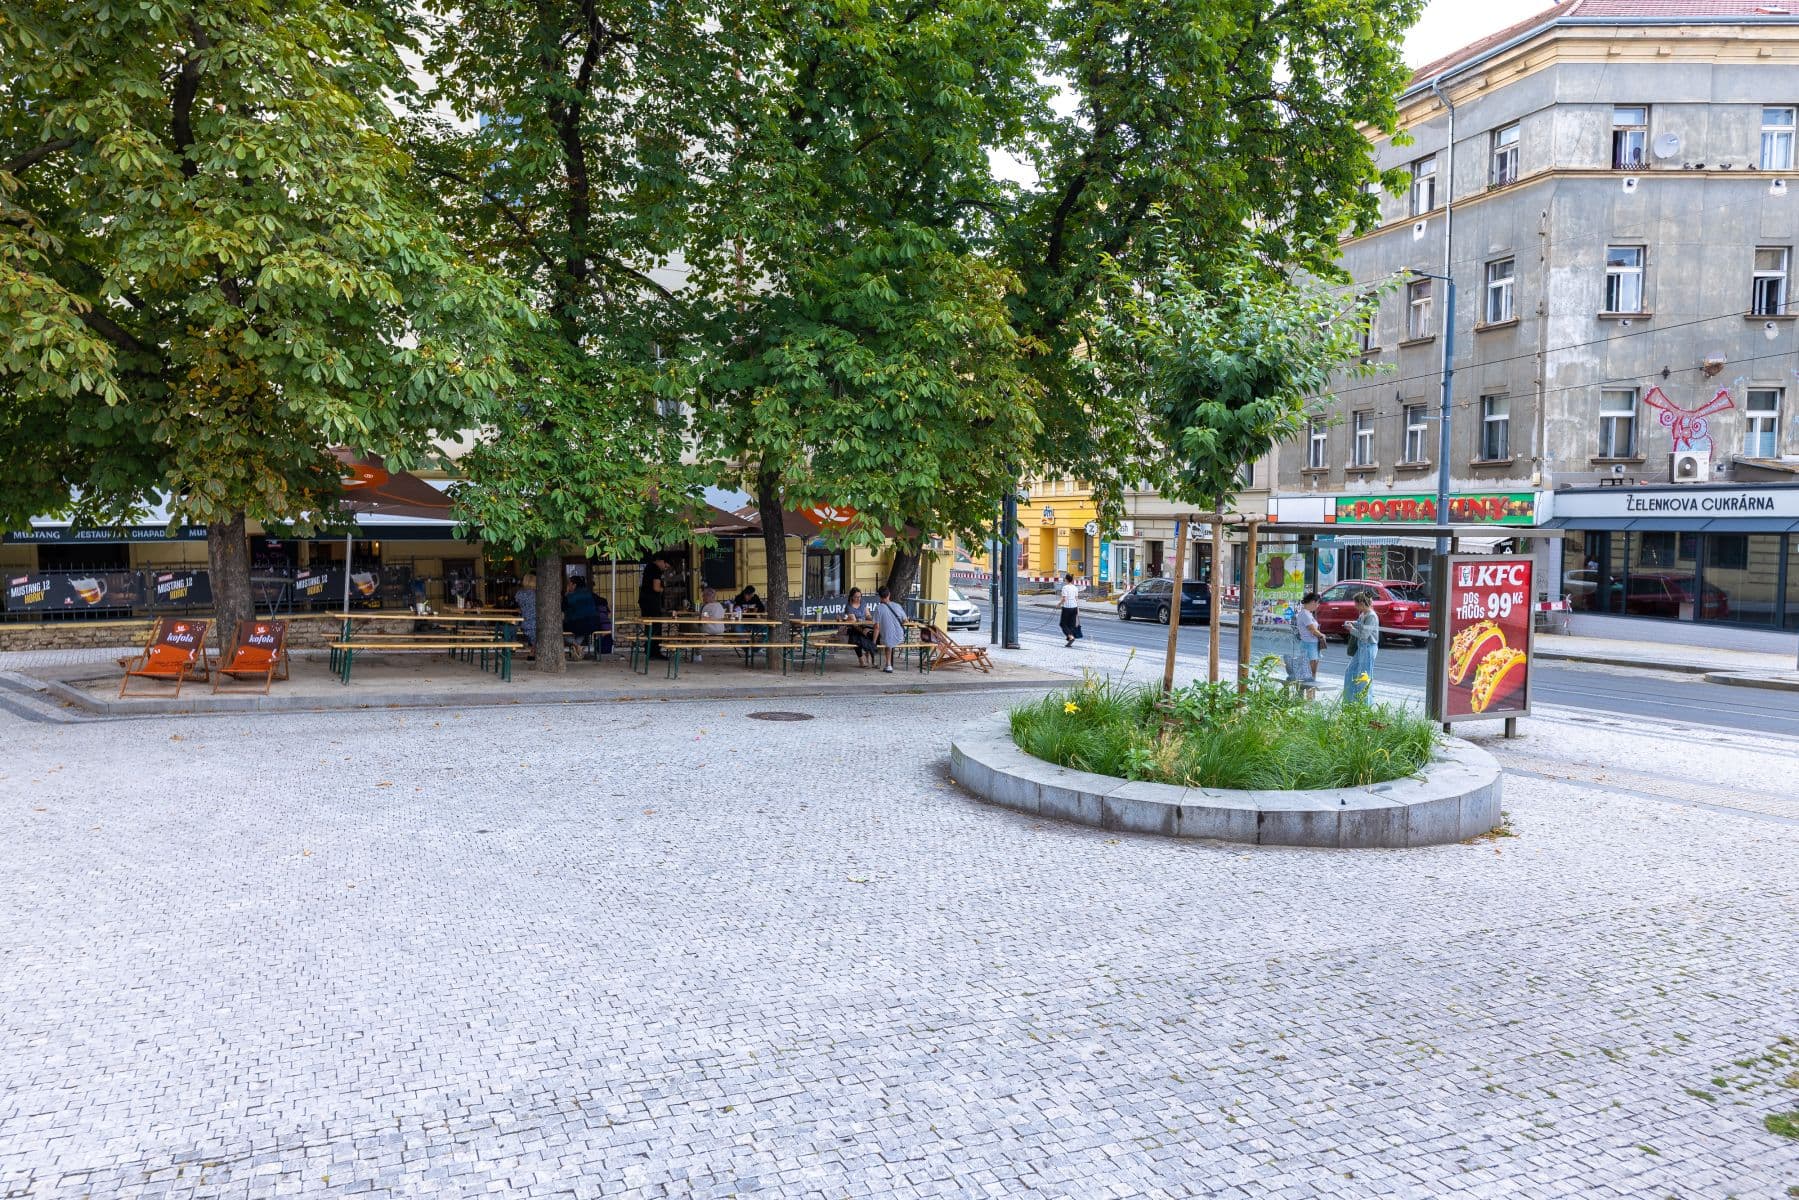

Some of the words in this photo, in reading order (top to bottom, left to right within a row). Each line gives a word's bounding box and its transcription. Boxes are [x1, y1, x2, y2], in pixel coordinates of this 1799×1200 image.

[1701, 493, 1775, 511] CUKRÁRNA
[132, 529, 166, 538] CHAPAD
[1475, 565, 1525, 586] KFC
[10, 582, 41, 598] MUSTANG
[42, 580, 50, 590] 12
[157, 578, 184, 594] MUSTANG
[1463, 592, 1480, 605] DOS
[1487, 592, 1512, 618] 99
[1512, 592, 1524, 605] Kč
[800, 604, 846, 616] RESAUR
[1456, 604, 1485, 620] TACOS
